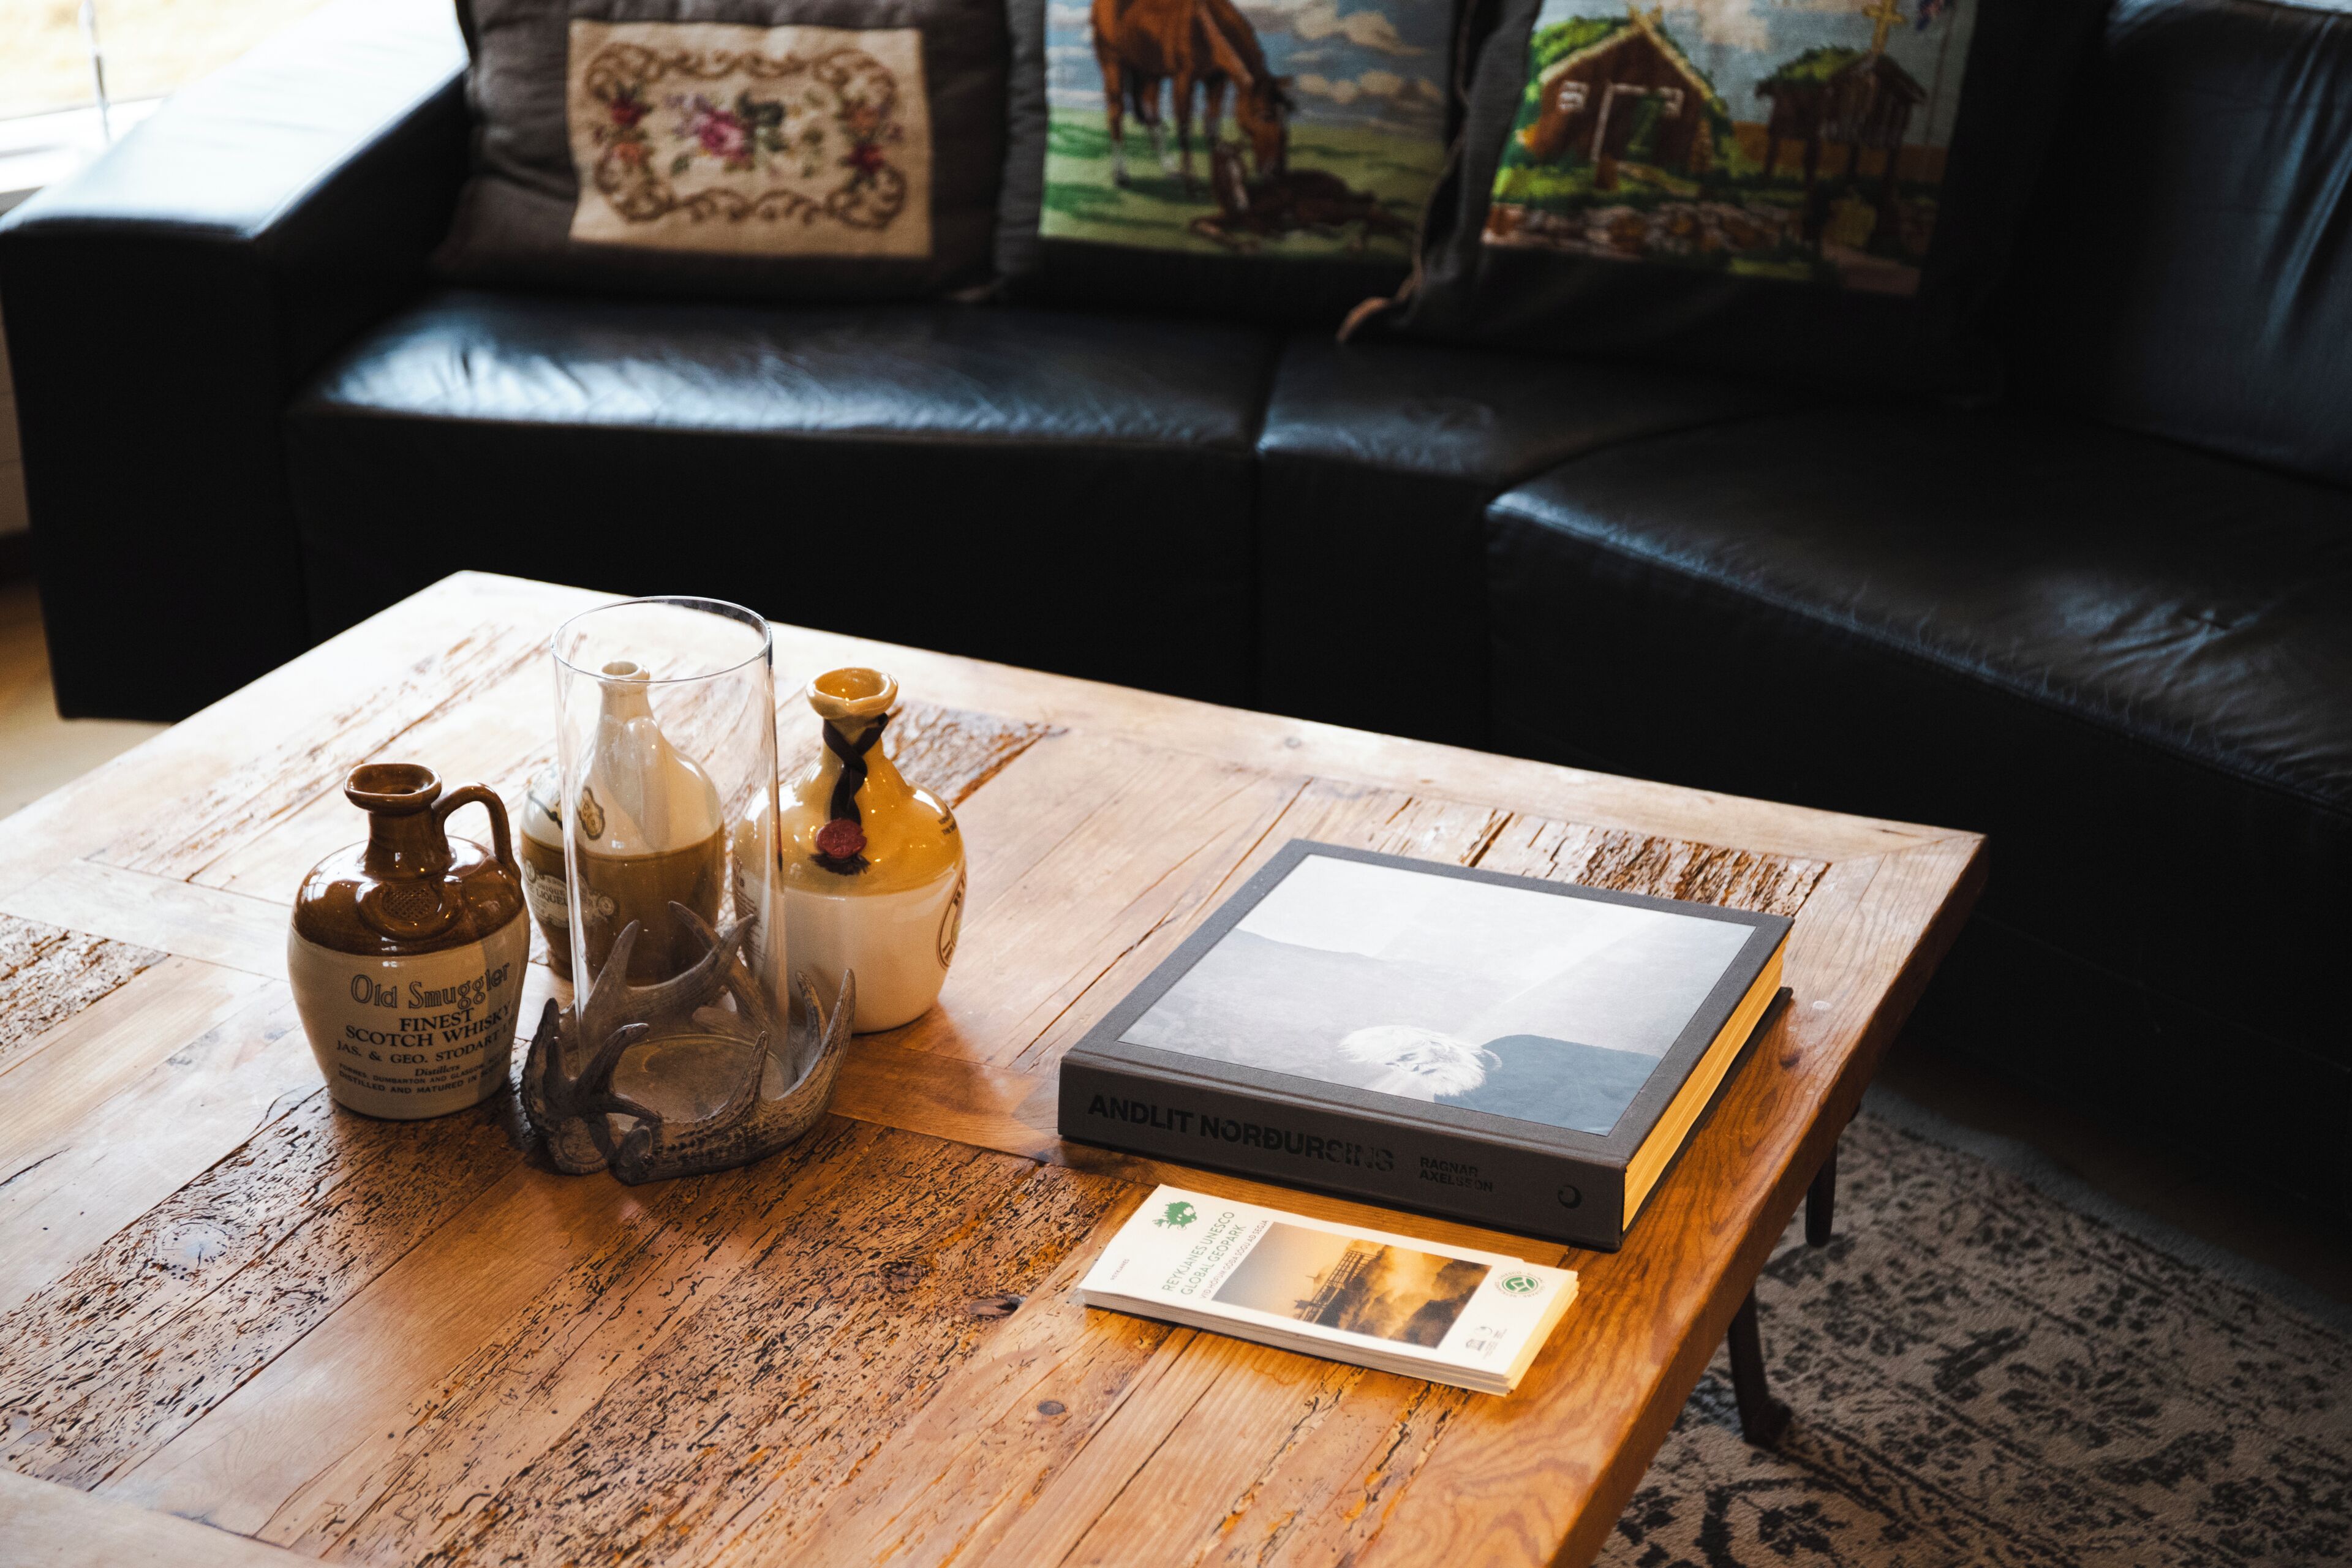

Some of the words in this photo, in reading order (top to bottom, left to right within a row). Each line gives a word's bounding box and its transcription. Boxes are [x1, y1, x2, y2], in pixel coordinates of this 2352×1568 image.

[351, 974, 398, 1008] Old
[409, 962, 510, 1009] Smuggler
[345, 1025, 433, 1047] SCOTCH
[442, 1001, 511, 1042] WHISKY
[399, 1008, 474, 1031] FINEST
[337, 1040, 362, 1057] JAS.
[369, 1051, 382, 1061] &
[390, 1054, 428, 1064] GEO.
[435, 1030, 500, 1062] STODART
[339, 1069, 386, 1091] DISTILLED
[417, 1080, 464, 1093] MATURED
[467, 1075, 477, 1084] IN
[373, 1075, 426, 1084] DUMBARTON
[415, 1065, 460, 1077] Distillers
[1088, 1095, 1194, 1133] ANDLIT
[1200, 1115, 1394, 1172] NORÐURSINS
[1420, 1156, 1478, 1177] RAGNAR
[1419, 1169, 1493, 1192] AXELSSON
[1252, 1220, 1268, 1235] SEGJA
[1162, 1245, 1208, 1291] REYKJANES
[1200, 1212, 1235, 1245] UNESCO
[1181, 1264, 1215, 1295] GLOBAL
[1207, 1224, 1246, 1262] GEOPARK
